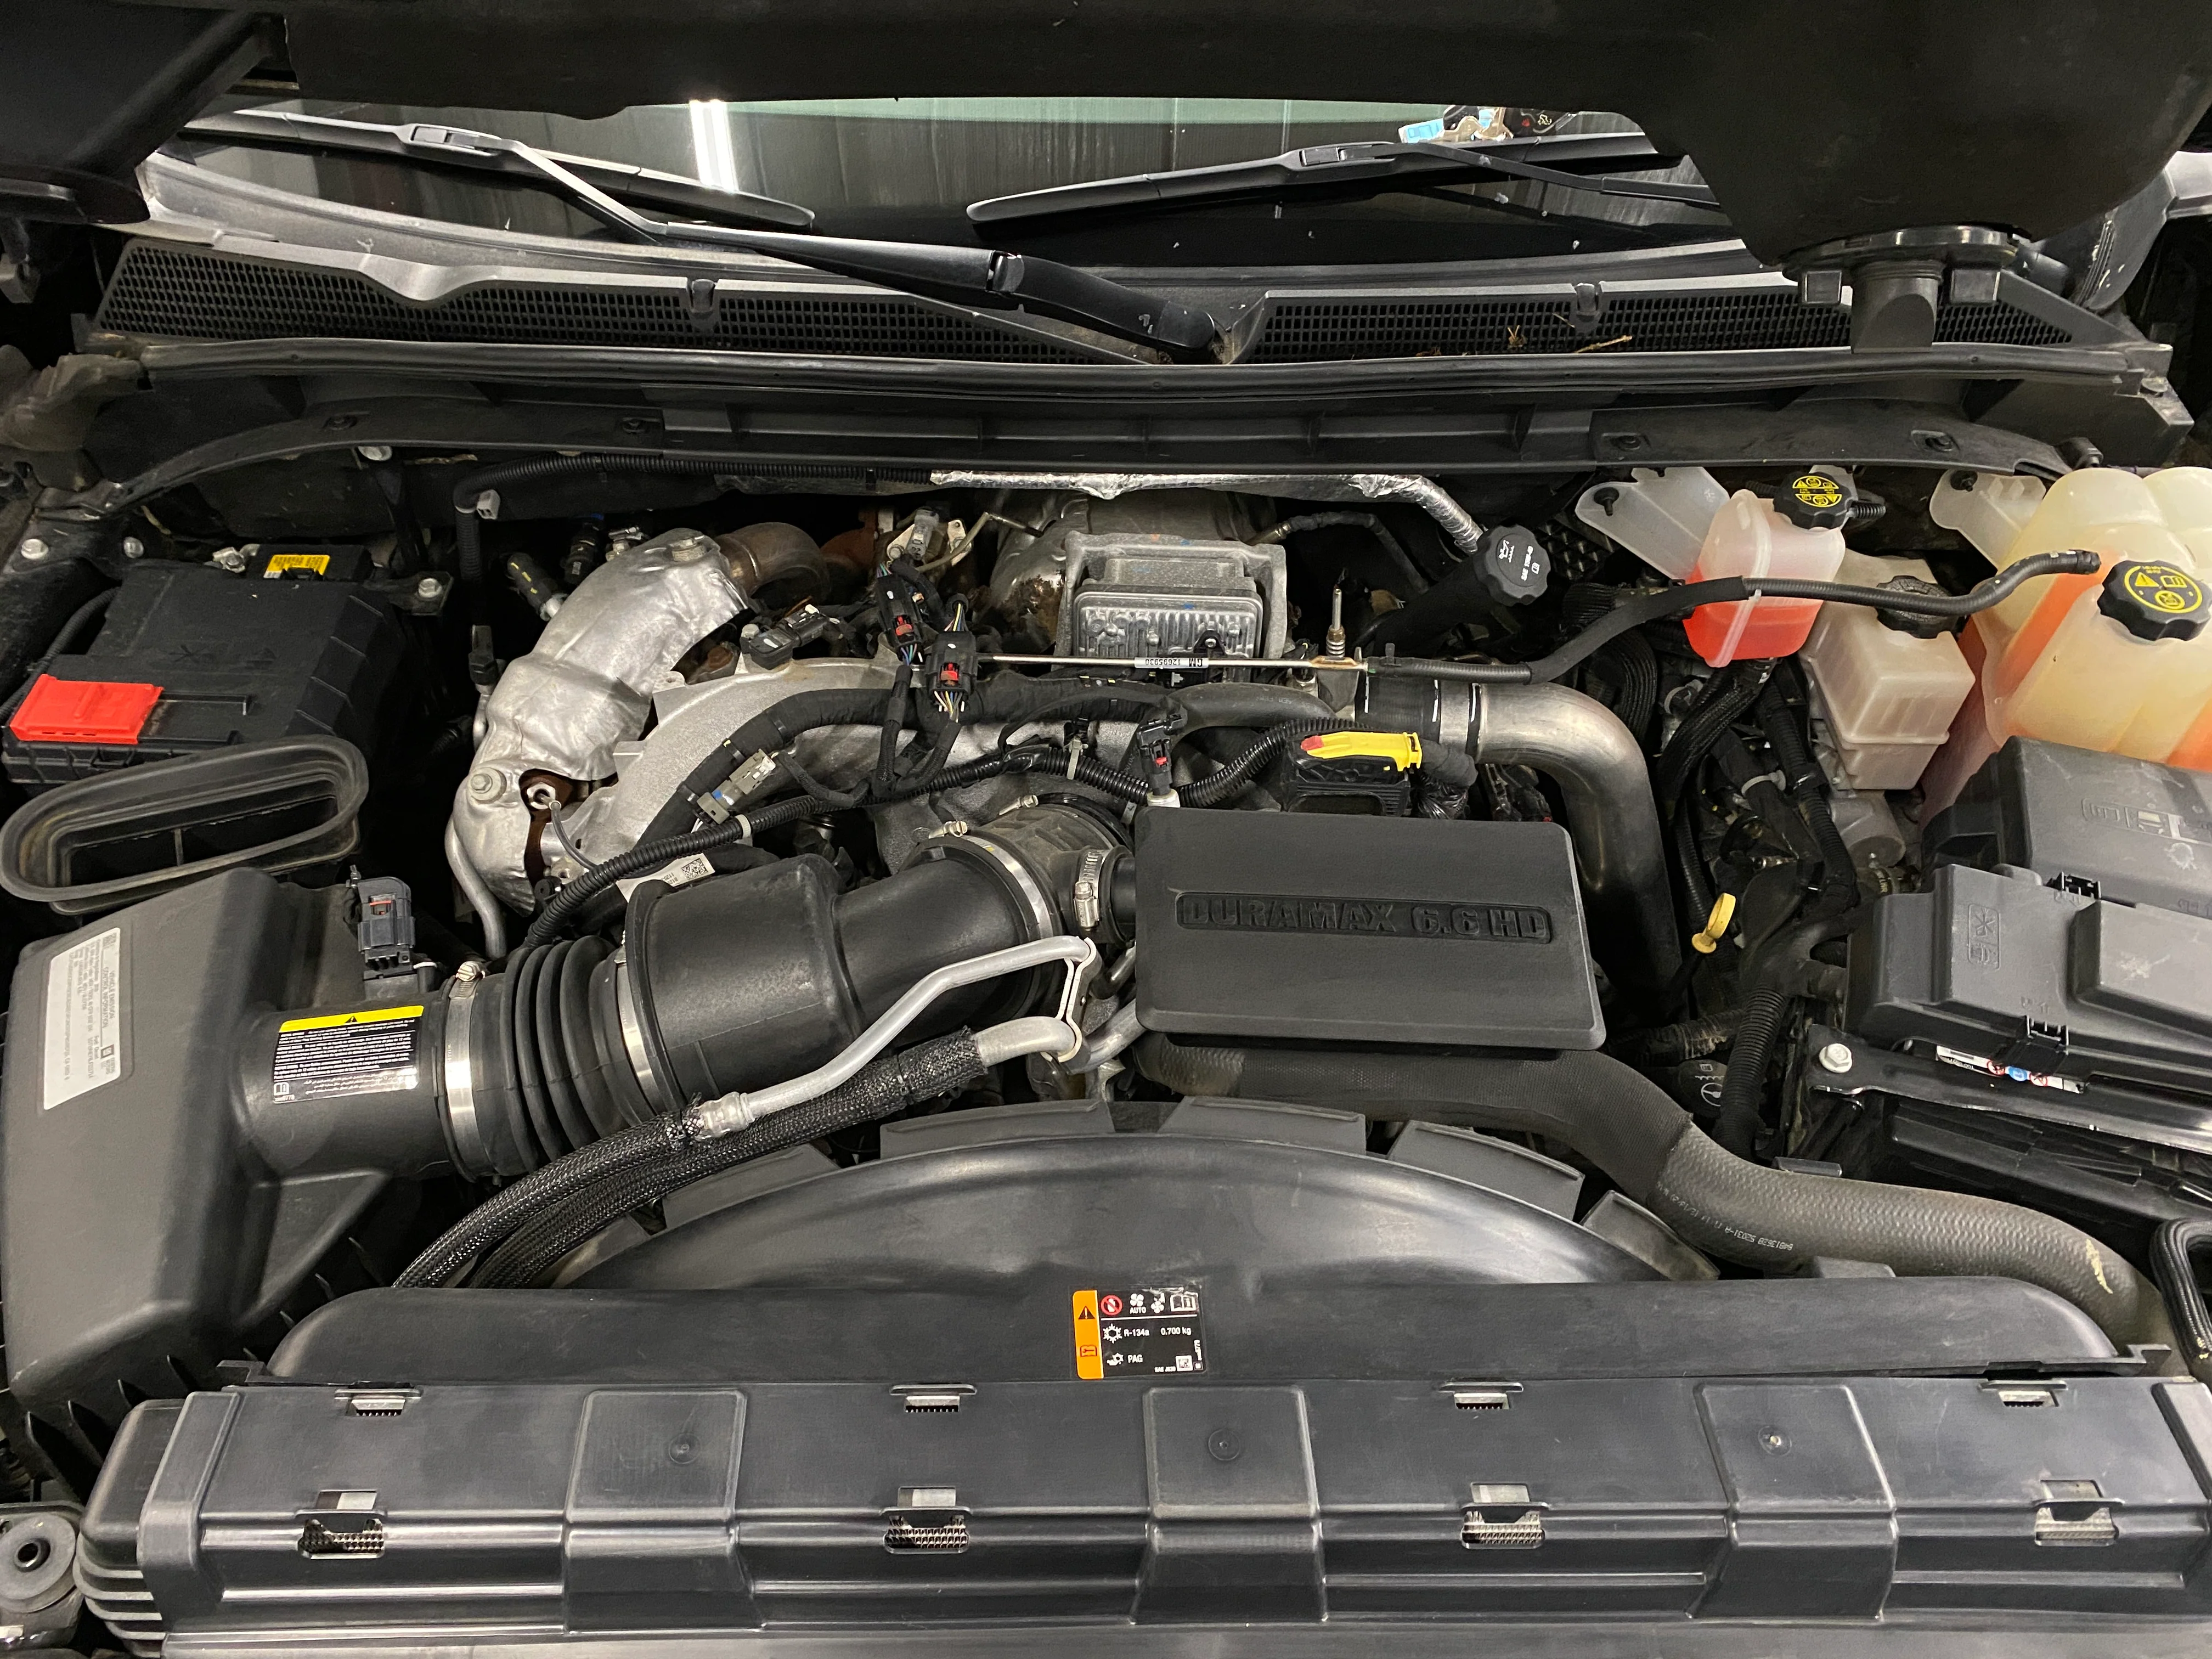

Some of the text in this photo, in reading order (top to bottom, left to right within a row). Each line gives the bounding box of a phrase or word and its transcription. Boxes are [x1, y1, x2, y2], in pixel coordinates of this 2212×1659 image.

[1189, 658, 1203, 667] GM
[1181, 896, 1547, 939] DURAMAX 6.6 HD
[1124, 1327, 1192, 1337] R-134a 0.700 kg
[1127, 1355, 1143, 1363] PAG
